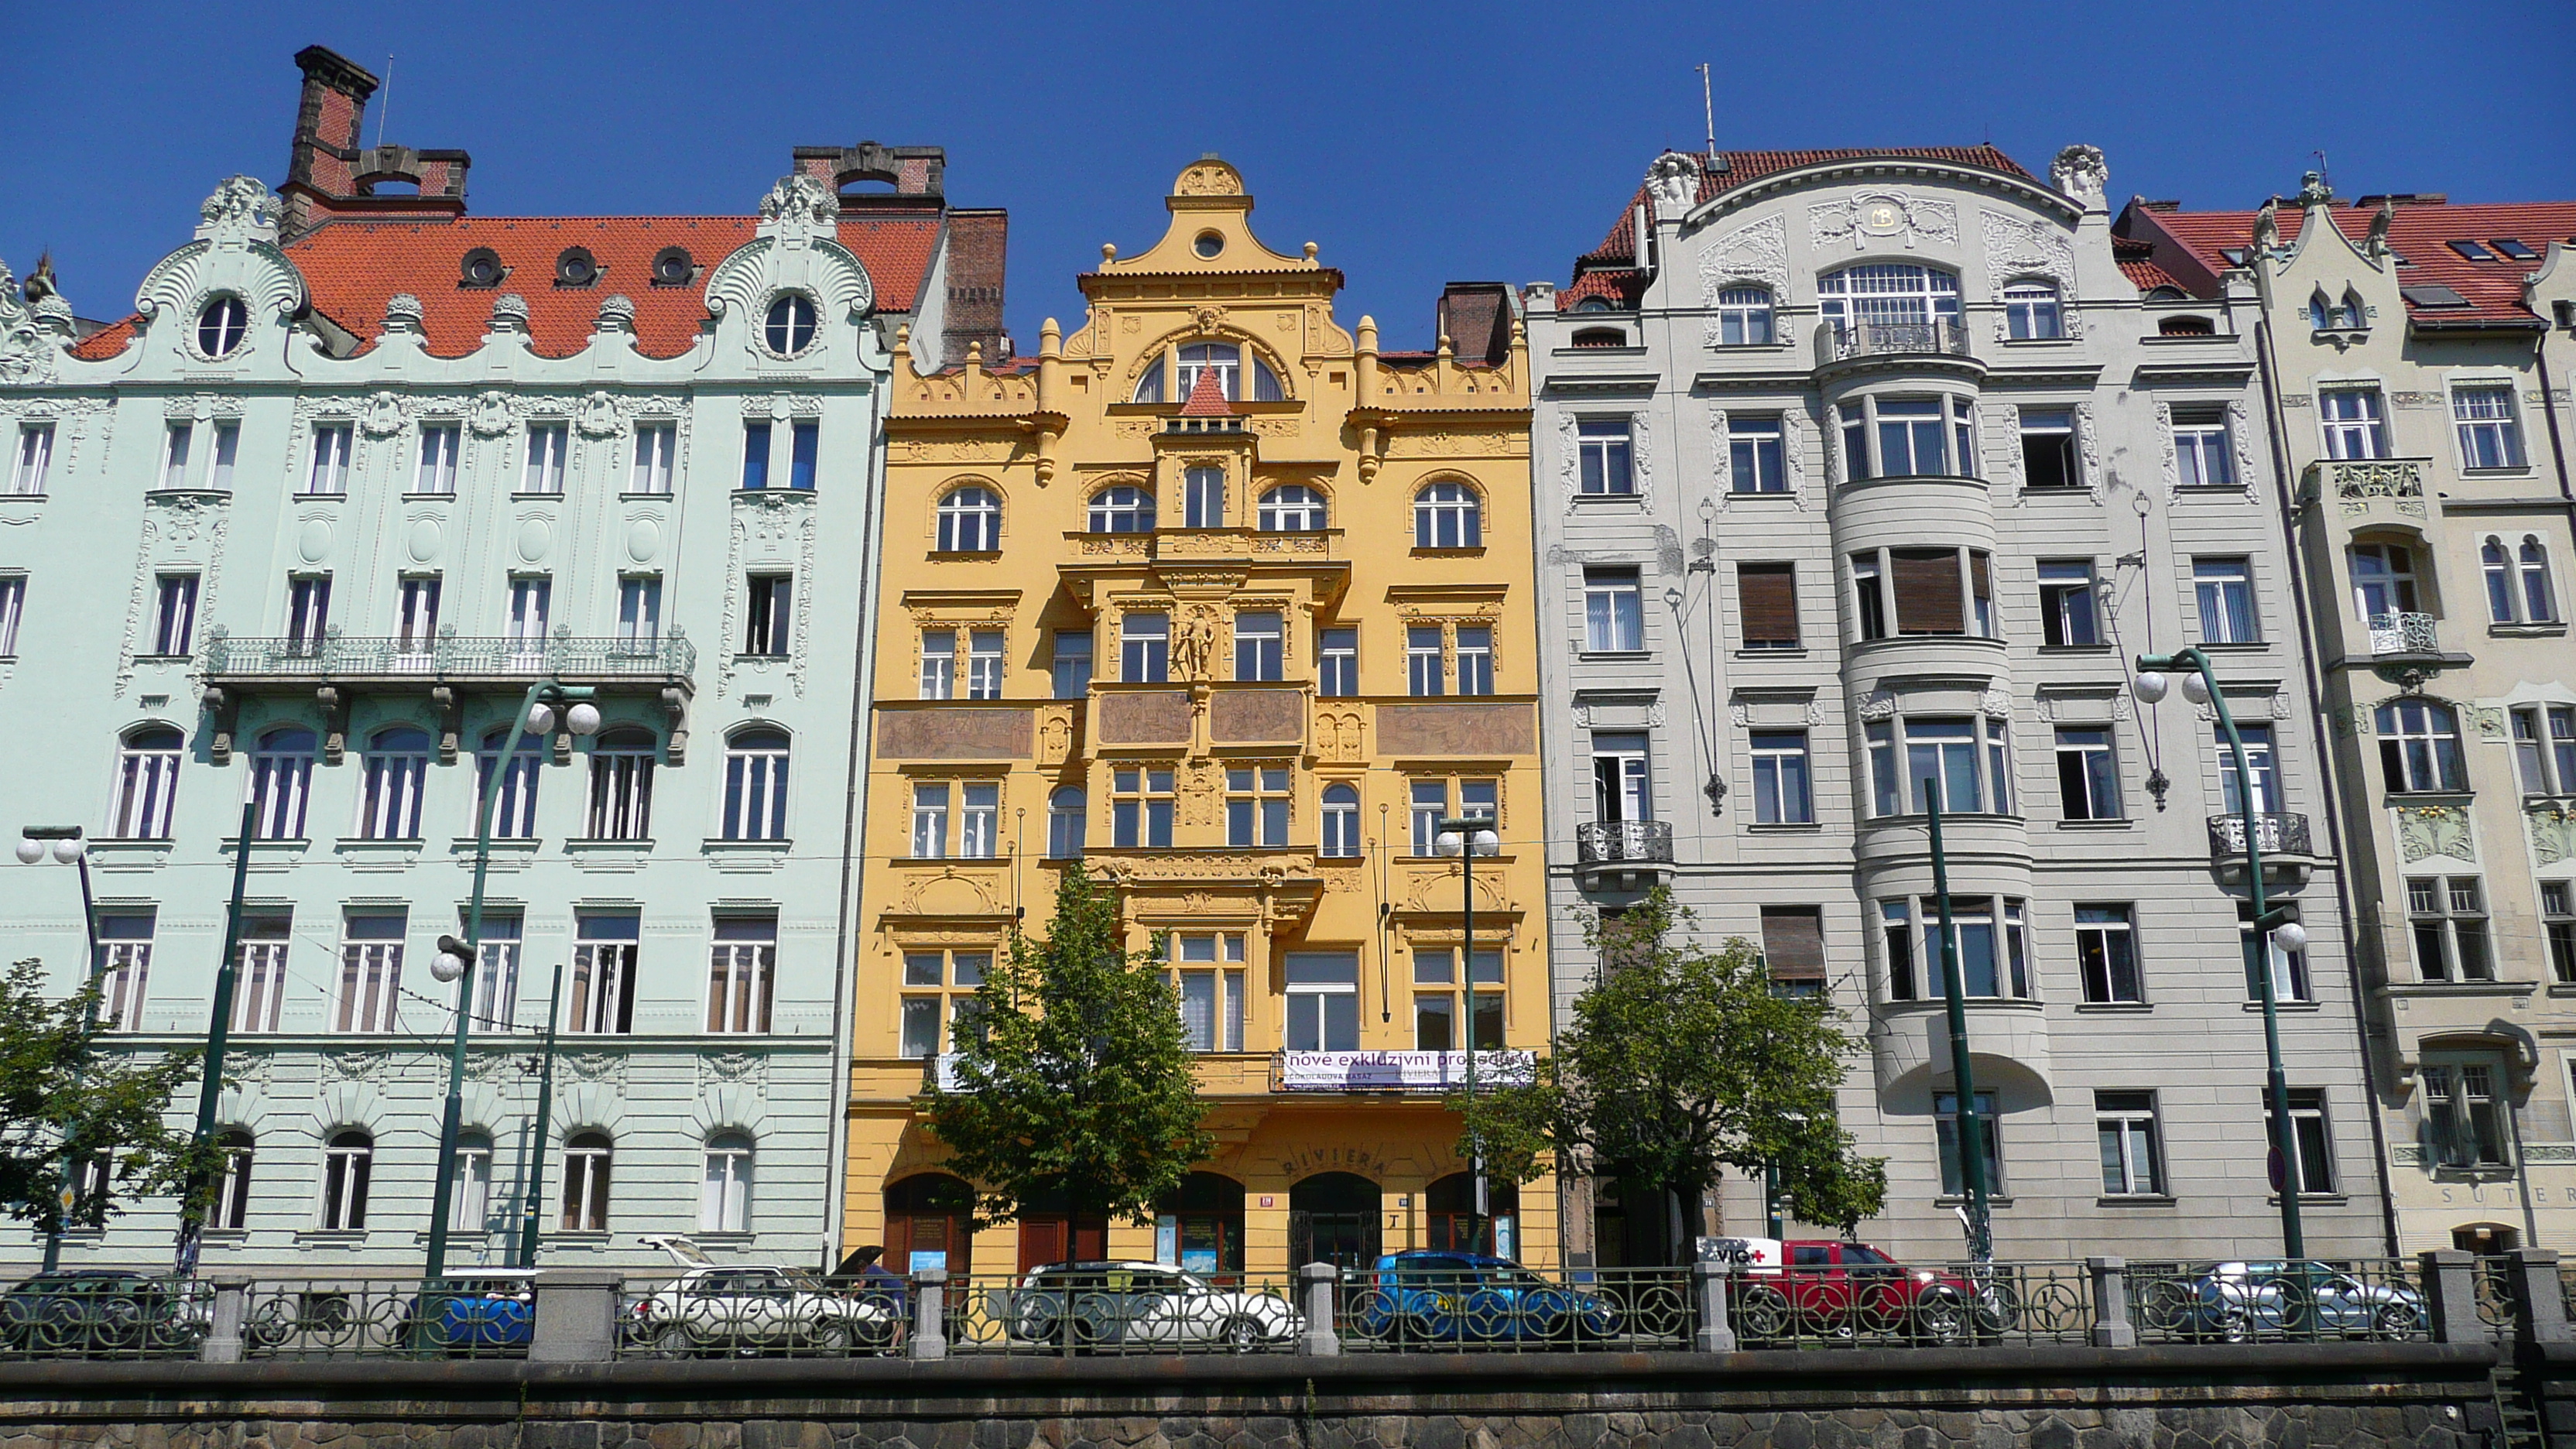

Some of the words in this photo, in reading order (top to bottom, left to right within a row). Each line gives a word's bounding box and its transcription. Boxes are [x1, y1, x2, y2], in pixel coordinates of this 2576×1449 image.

[1290, 1053, 1332, 1067] nové
[1338, 1053, 1430, 1067] exkluzivní
[1394, 1069, 1439, 1077] RIVIERA
[1283, 1148, 1385, 1175] RIVIERA
